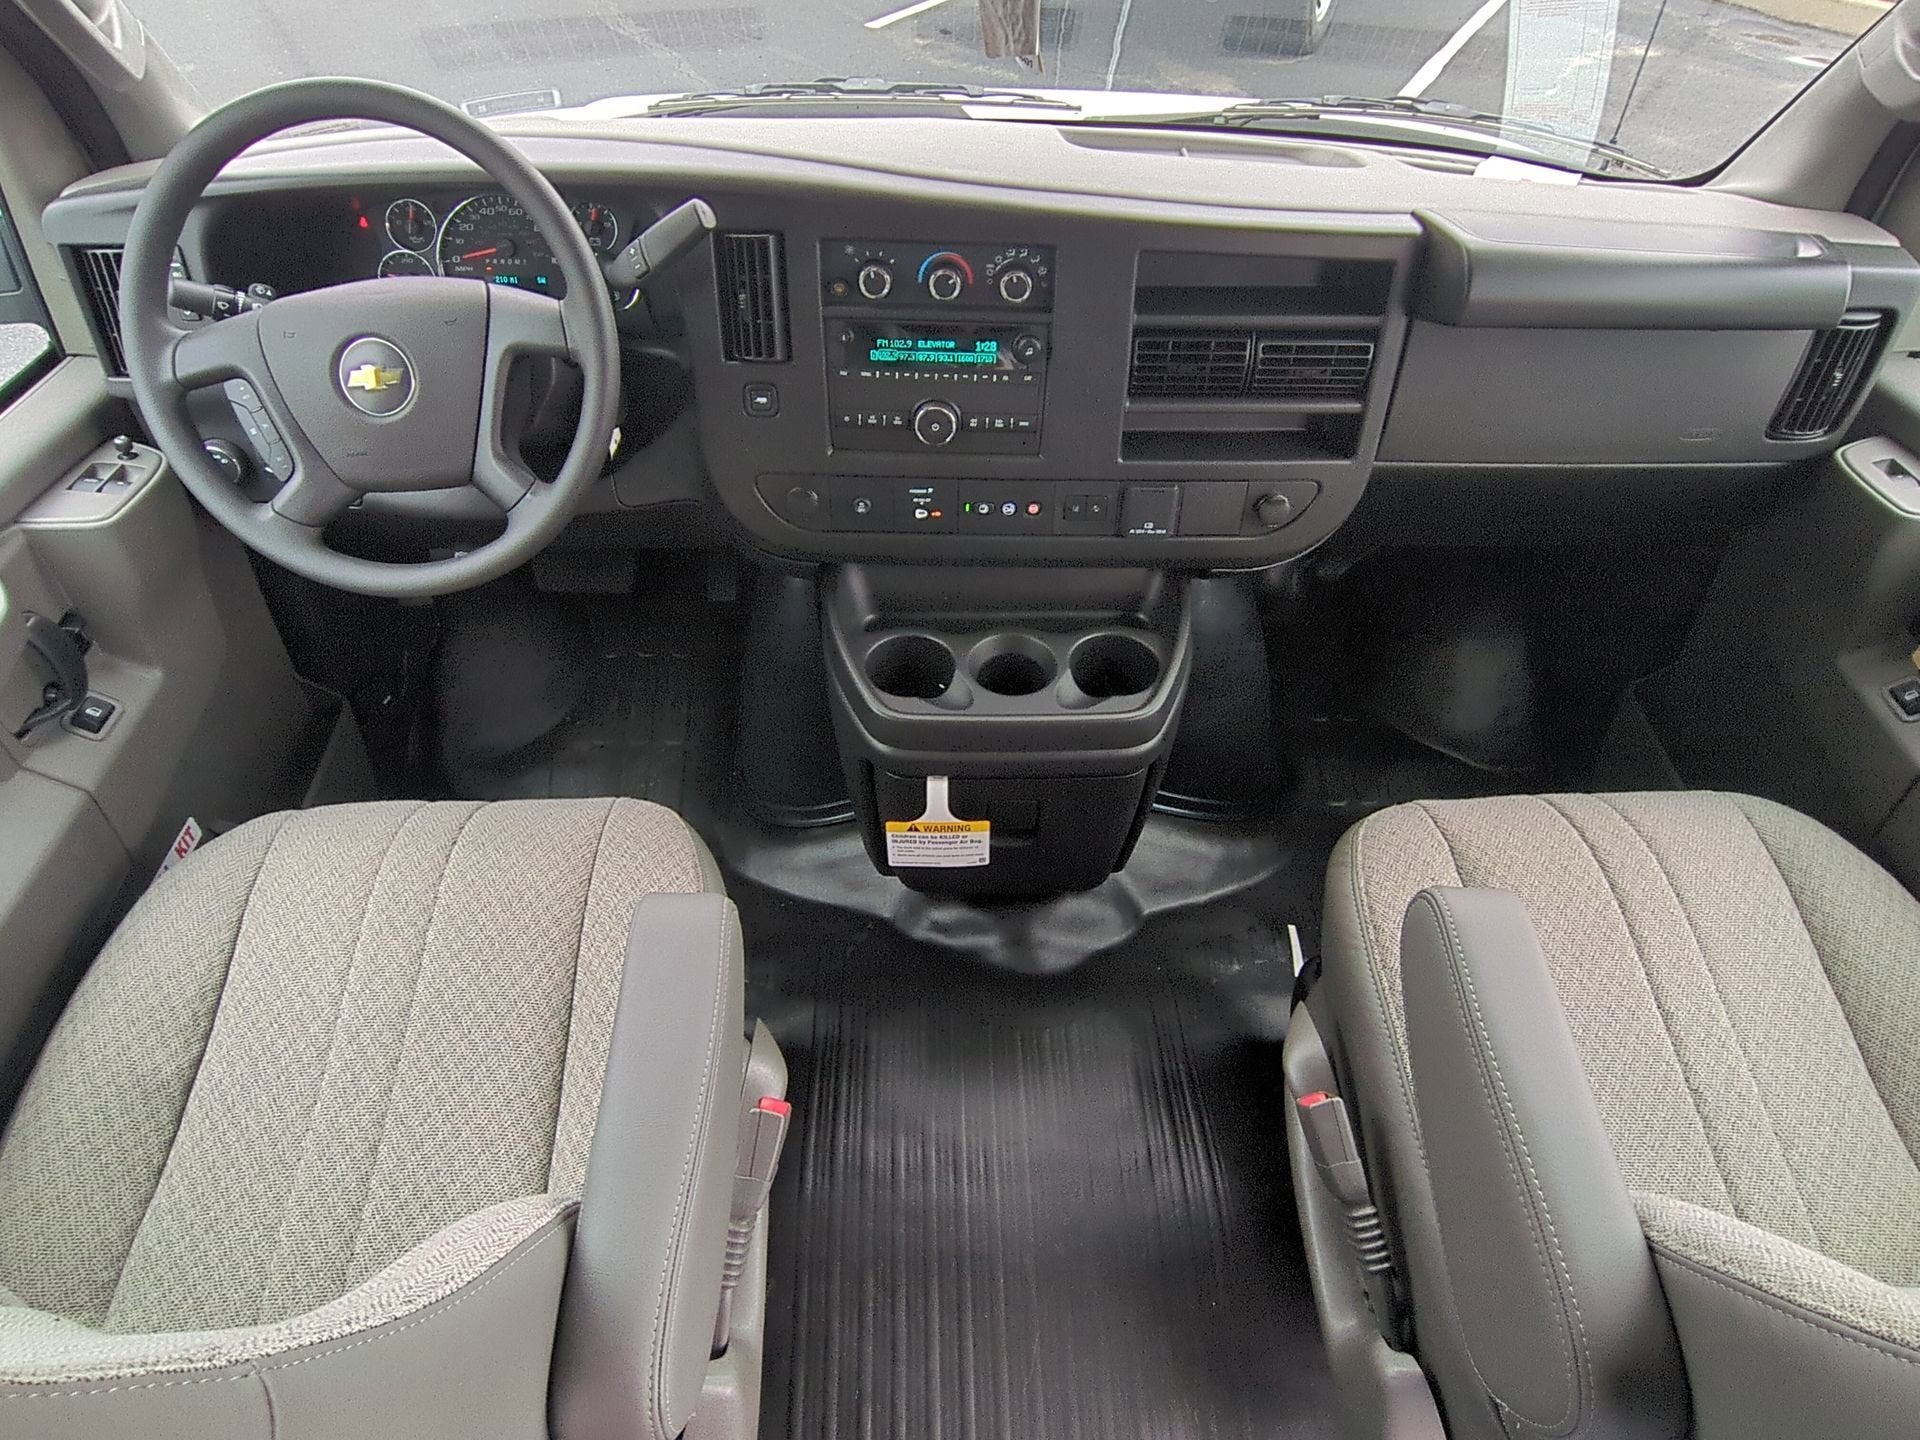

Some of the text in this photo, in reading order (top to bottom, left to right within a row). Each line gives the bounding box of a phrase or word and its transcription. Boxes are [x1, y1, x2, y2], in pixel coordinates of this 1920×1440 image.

[479, 207, 495, 216] 40
[508, 208, 523, 216] 60
[459, 223, 474, 231] 20
[452, 255, 460, 263] 0
[495, 275, 508, 284] 210
[918, 340, 956, 349] ELEVATOR
[976, 341, 997, 352] 1:28
[924, 825, 971, 833] WARNING
[175, 825, 195, 859] KIT
